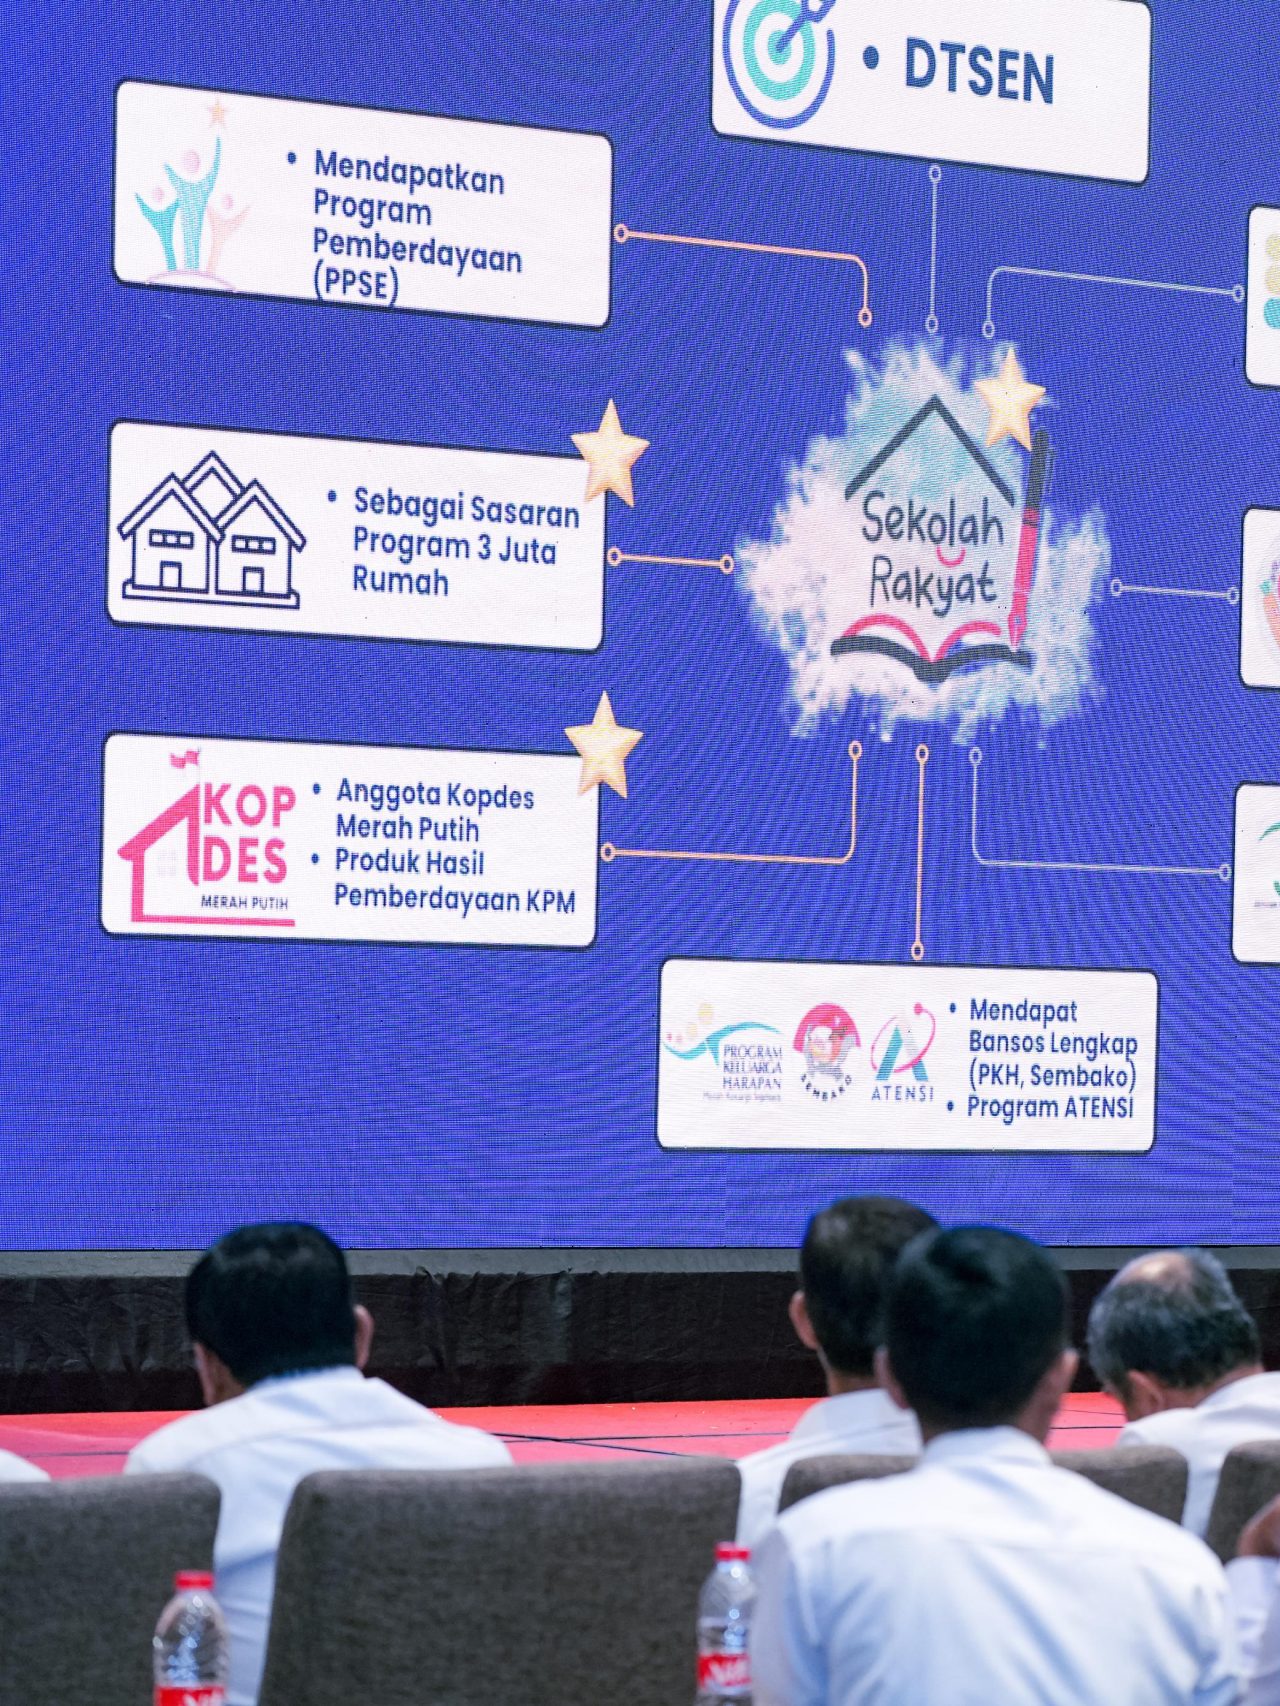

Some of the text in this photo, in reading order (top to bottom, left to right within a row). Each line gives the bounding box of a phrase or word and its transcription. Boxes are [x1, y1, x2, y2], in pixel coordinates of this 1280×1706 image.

[905, 36, 1054, 104] DTSEN
[315, 149, 505, 195] Mendapatkan
[314, 189, 432, 228] Program
[313, 228, 523, 277] Pemberdayaan
[314, 260, 399, 307] (PPSE)
[354, 487, 580, 528] Sebagai Sasaran
[861, 490, 1004, 547] Sekolah
[353, 526, 557, 566] Program 3 Juta
[353, 566, 449, 597] Rumah
[869, 556, 998, 618] Rakyat
[204, 783, 296, 827] KOP
[336, 777, 535, 815] Anggota Kopdes
[336, 814, 480, 842] Merah Putih
[203, 837, 287, 884] DES
[335, 848, 485, 876] Produk Hasil
[201, 894, 288, 910] MERAH PUTIH
[334, 883, 576, 919] Pemberdayaan KPM
[970, 998, 1078, 1030] Mendapat
[968, 1030, 1138, 1061] Bansos Lengkap
[722, 1076, 782, 1090] HARAPAN
[871, 1085, 934, 1102] ATENSI
[968, 1060, 1137, 1092] (PKH, Sembako)
[967, 1096, 1134, 1126] Program ATENSI
